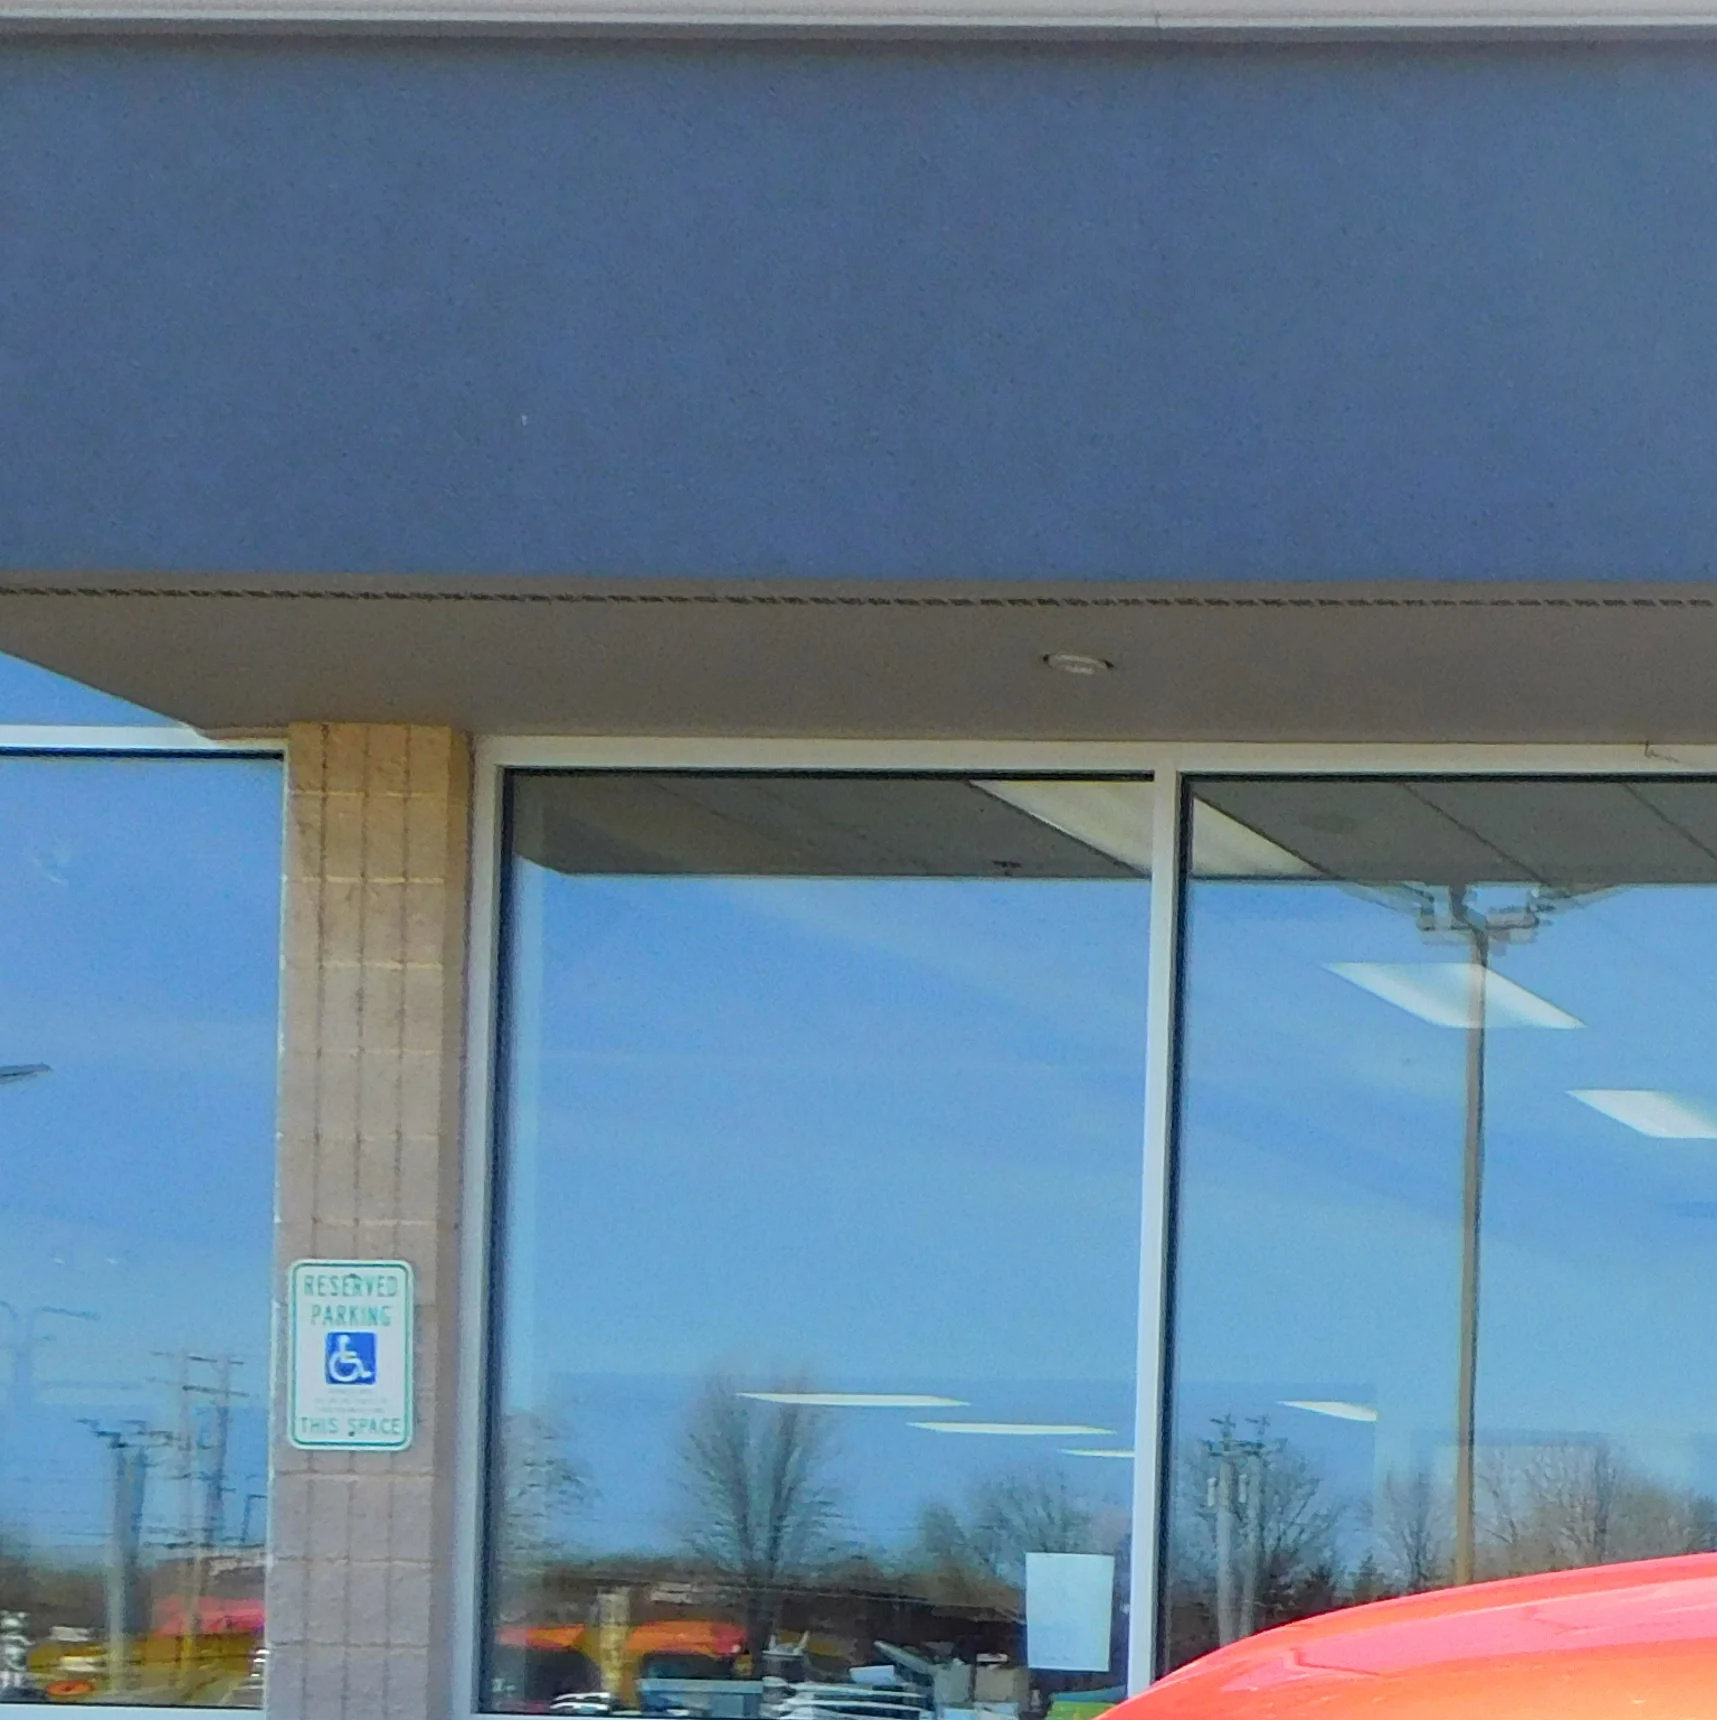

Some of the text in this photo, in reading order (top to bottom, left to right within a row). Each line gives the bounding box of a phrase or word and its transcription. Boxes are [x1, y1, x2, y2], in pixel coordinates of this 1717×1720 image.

[303, 1273, 398, 1298] RESERVED
[310, 1304, 392, 1327] PARKING
[299, 1416, 401, 1436] THIS SPACE
